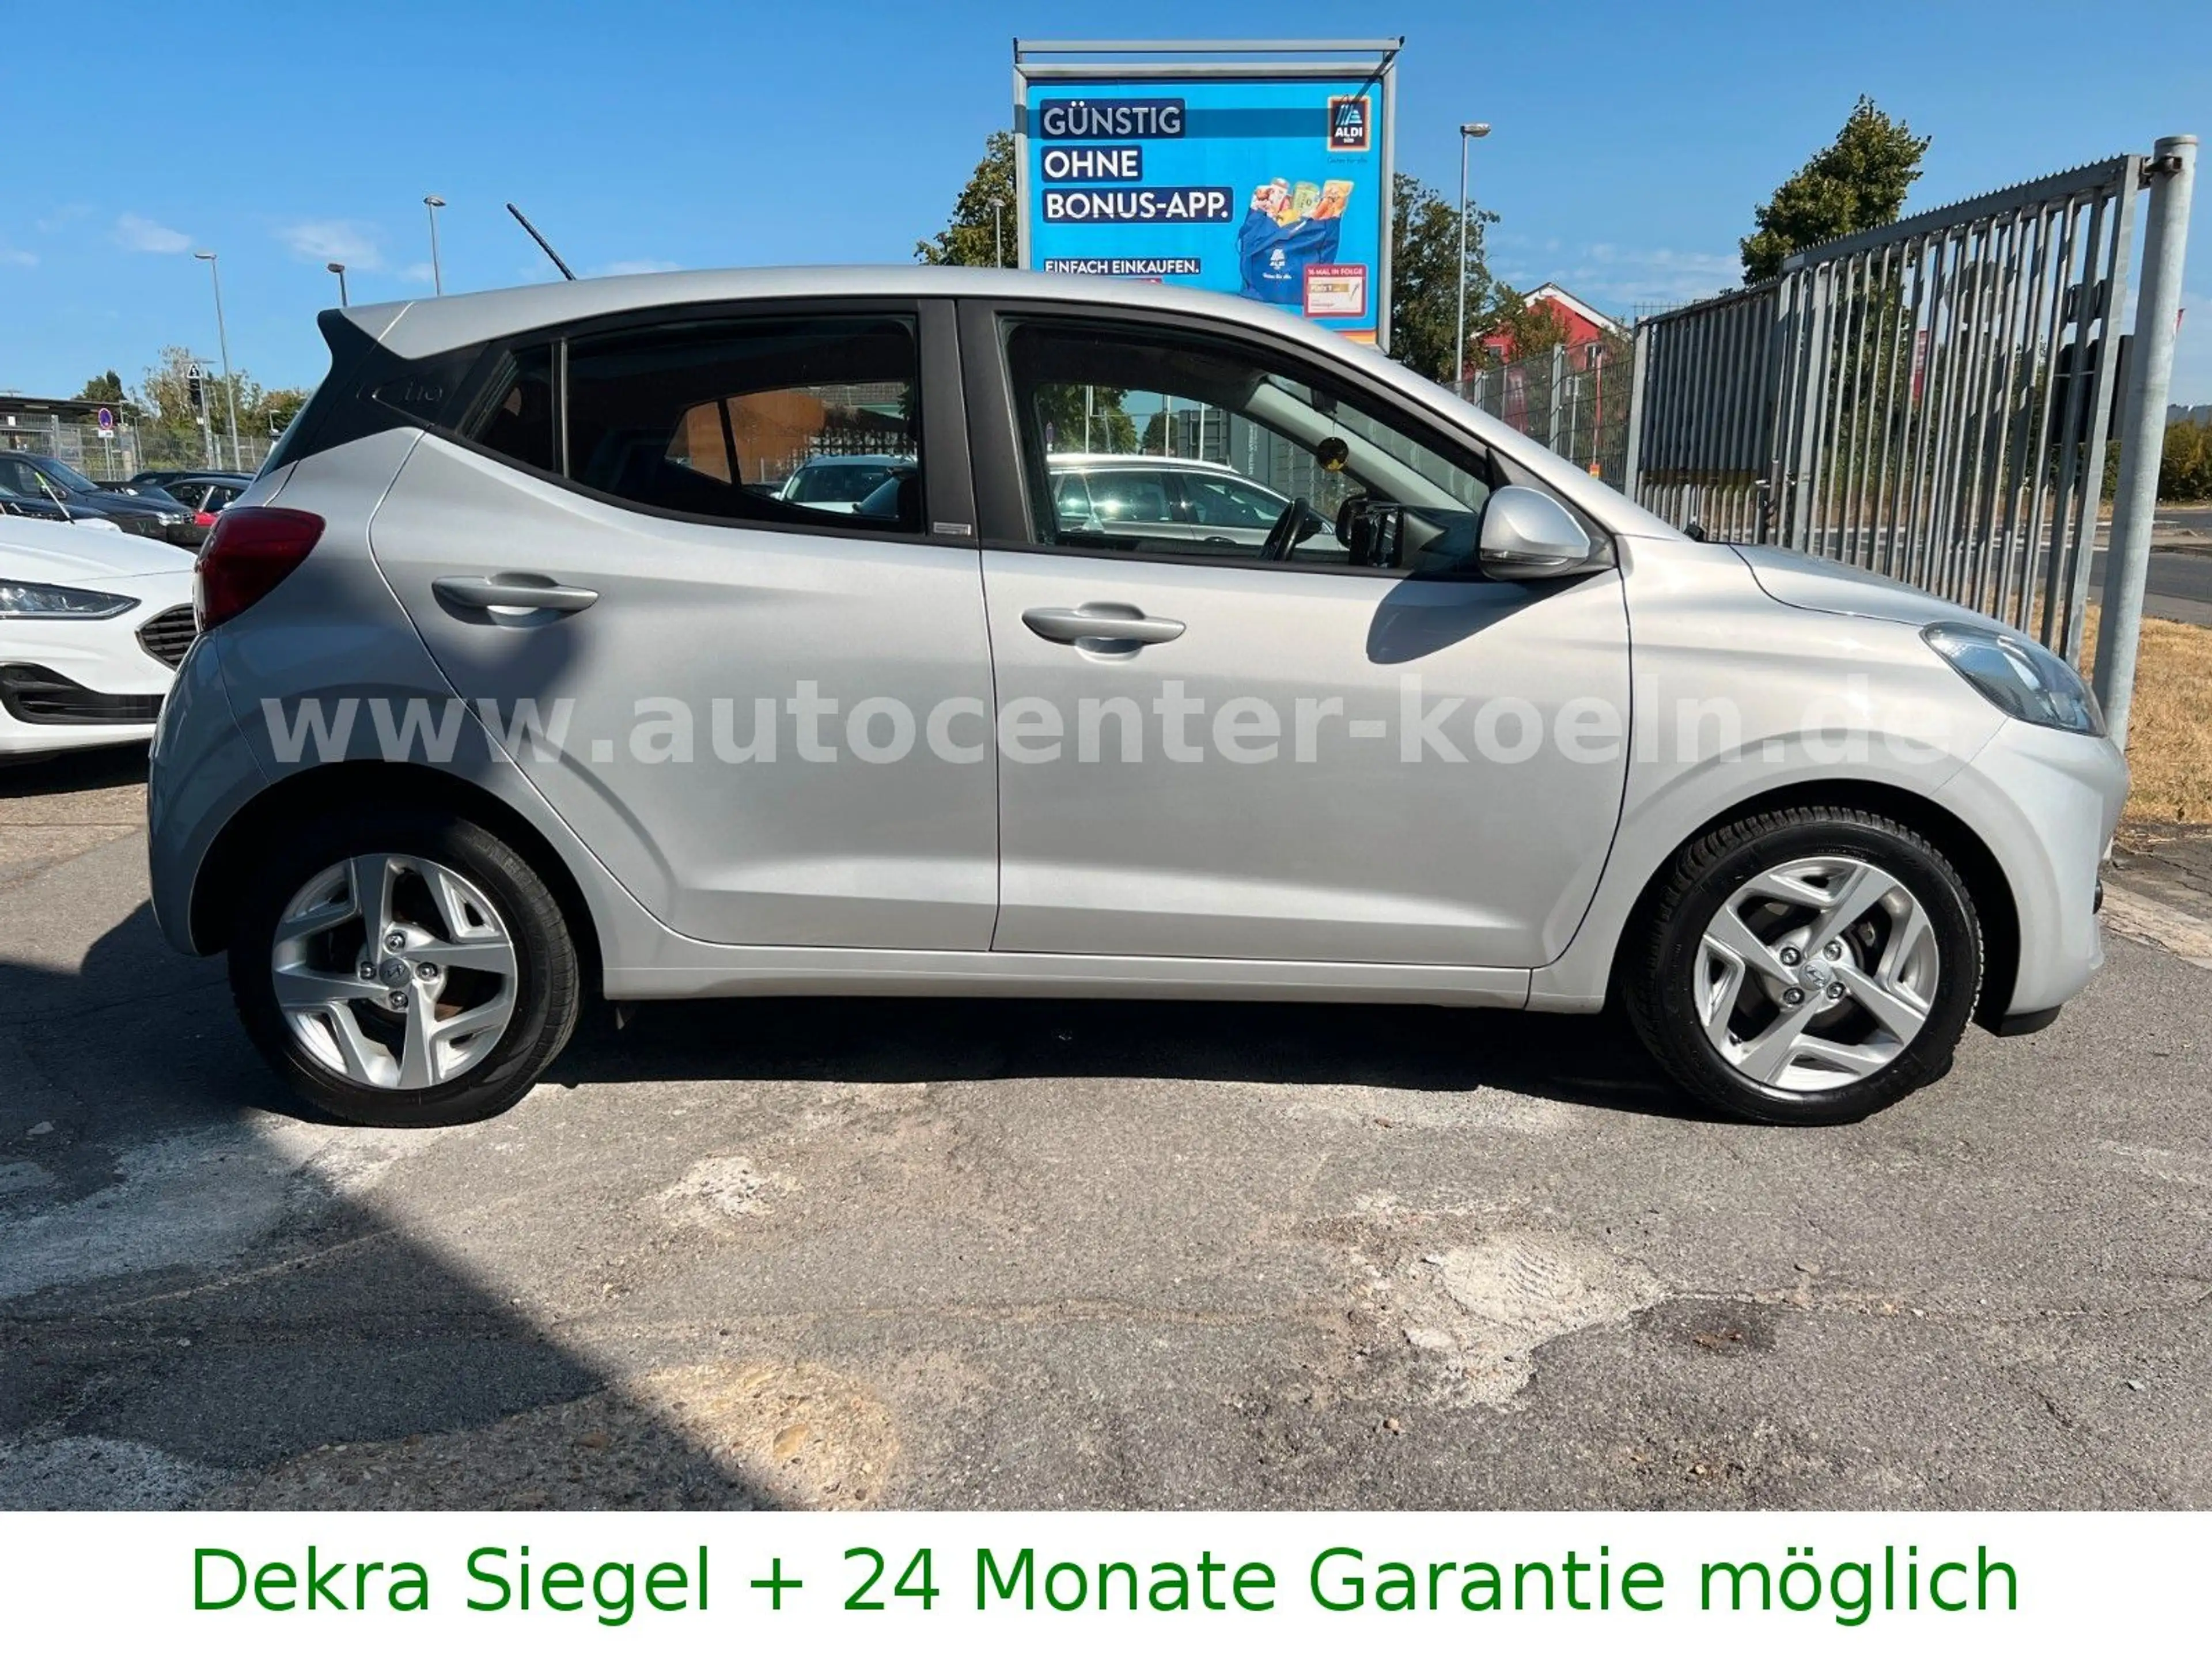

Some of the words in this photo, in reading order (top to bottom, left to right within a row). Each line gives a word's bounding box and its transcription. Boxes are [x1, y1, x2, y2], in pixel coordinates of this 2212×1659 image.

[1043, 100, 1180, 135] GÜNSTIG
[1335, 127, 1363, 138] ALDI
[1044, 150, 1138, 179] OHNE
[1046, 192, 1229, 219] BONUS-APP.
[1045, 260, 1108, 274] EINFACH
[1112, 260, 1199, 274] EINKAUFEN.
